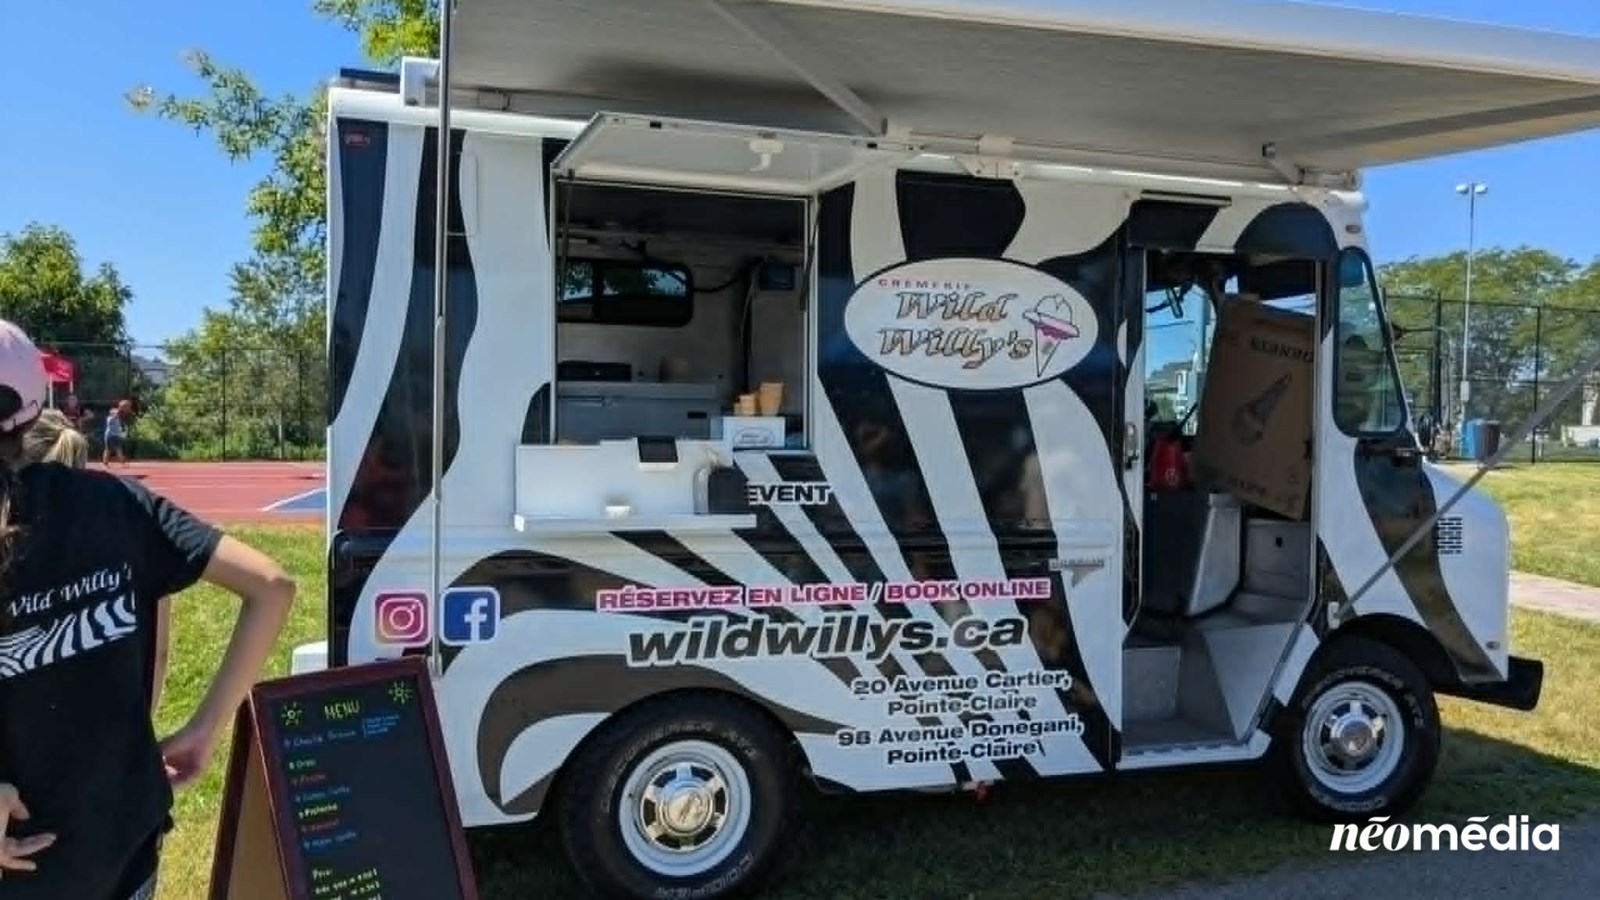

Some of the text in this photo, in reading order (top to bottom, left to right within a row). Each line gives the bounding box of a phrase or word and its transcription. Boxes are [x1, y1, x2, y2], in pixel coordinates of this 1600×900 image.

[896, 291, 1018, 322] Wild
[877, 326, 1034, 370] Willy's
[744, 484, 832, 502] EVENT
[599, 586, 740, 609] RÉSERVEZ
[748, 588, 782, 603] EN
[791, 585, 865, 603] LIGNE
[887, 582, 957, 600] BOOK
[964, 580, 1049, 598] ONLINE
[629, 614, 1025, 664] wildwillys.ca
[854, 670, 1071, 695] 20 Avenue Cartier,
[324, 700, 361, 721] MENU
[887, 694, 1038, 716] Pointe-Claire
[879, 725, 964, 744] Avenue
[971, 715, 1083, 738] Donegani,
[887, 741, 1038, 765] Pointe-Claire
